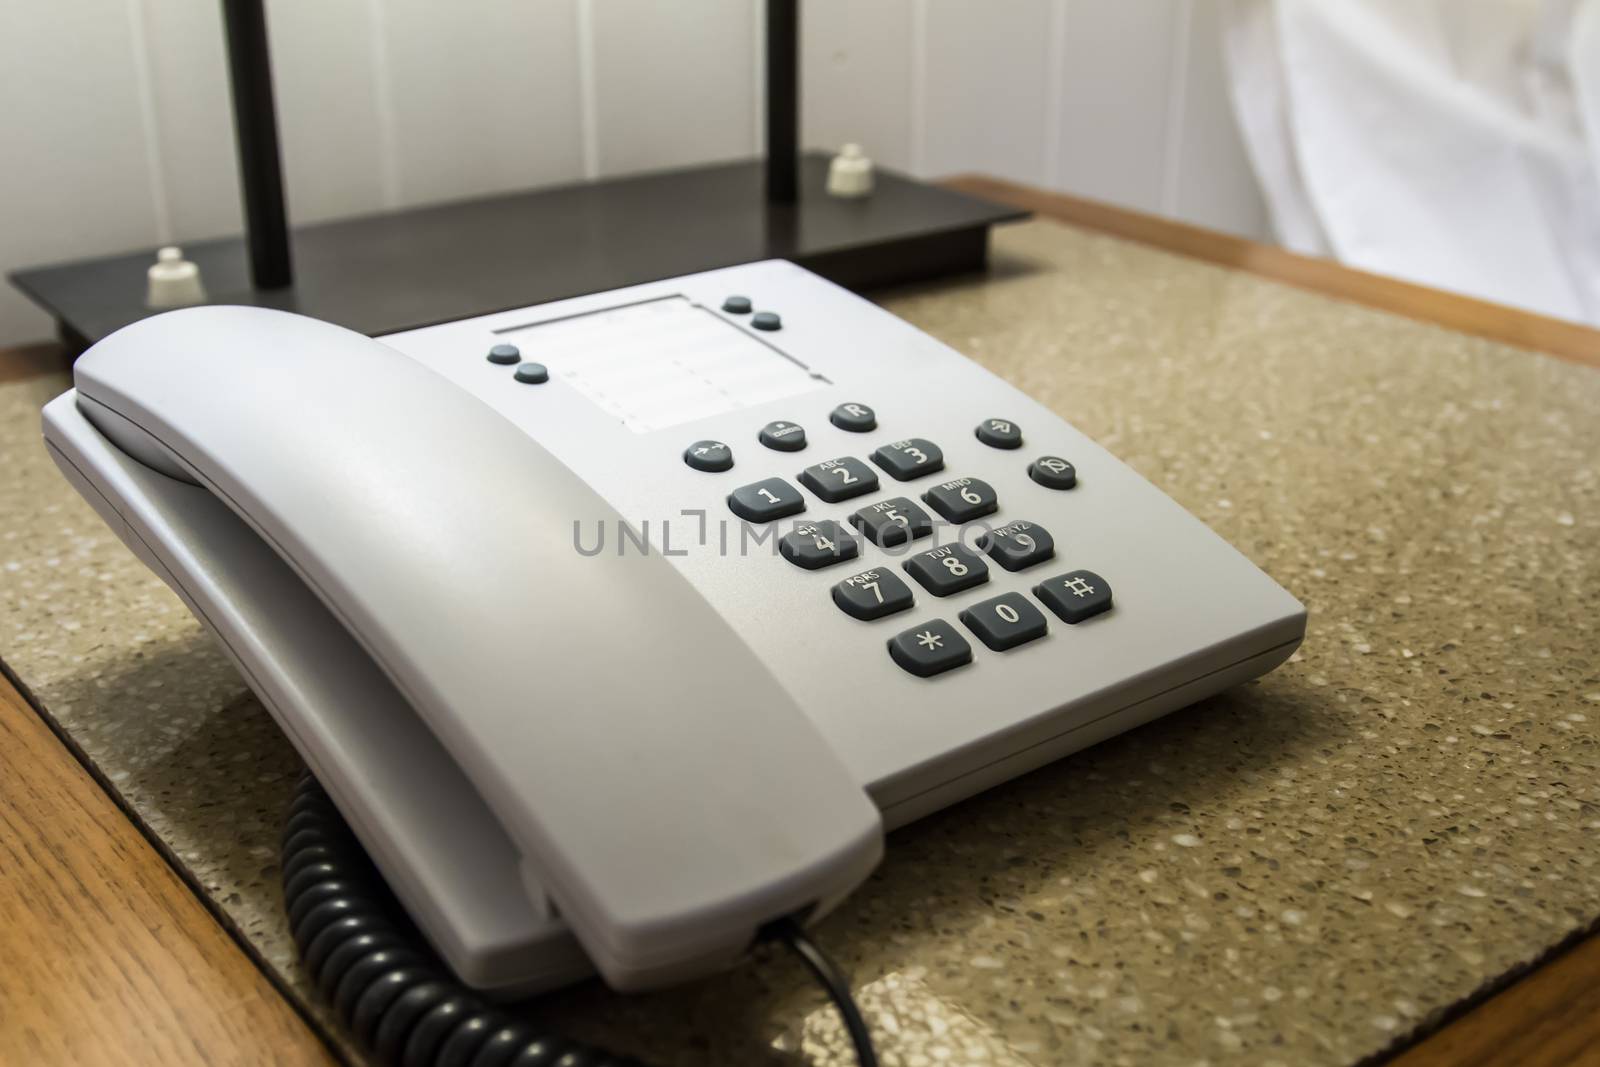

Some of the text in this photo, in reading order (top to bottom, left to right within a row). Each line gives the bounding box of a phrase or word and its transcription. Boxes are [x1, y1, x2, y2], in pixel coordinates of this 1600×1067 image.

[845, 404, 868, 417] R
[904, 448, 928, 464] 3
[819, 460, 845, 471] ABC
[832, 468, 858, 485] 2
[942, 478, 972, 491] MNO
[758, 488, 781, 504] 1
[960, 489, 983, 505] 6
[873, 502, 896, 514] JKL
[887, 509, 909, 529] 5
[815, 536, 836, 552] 4
[1014, 533, 1036, 553] 9
[926, 547, 953, 561] TUV
[942, 557, 969, 577] 8
[862, 581, 885, 605] 7
[995, 604, 1020, 624] 0
